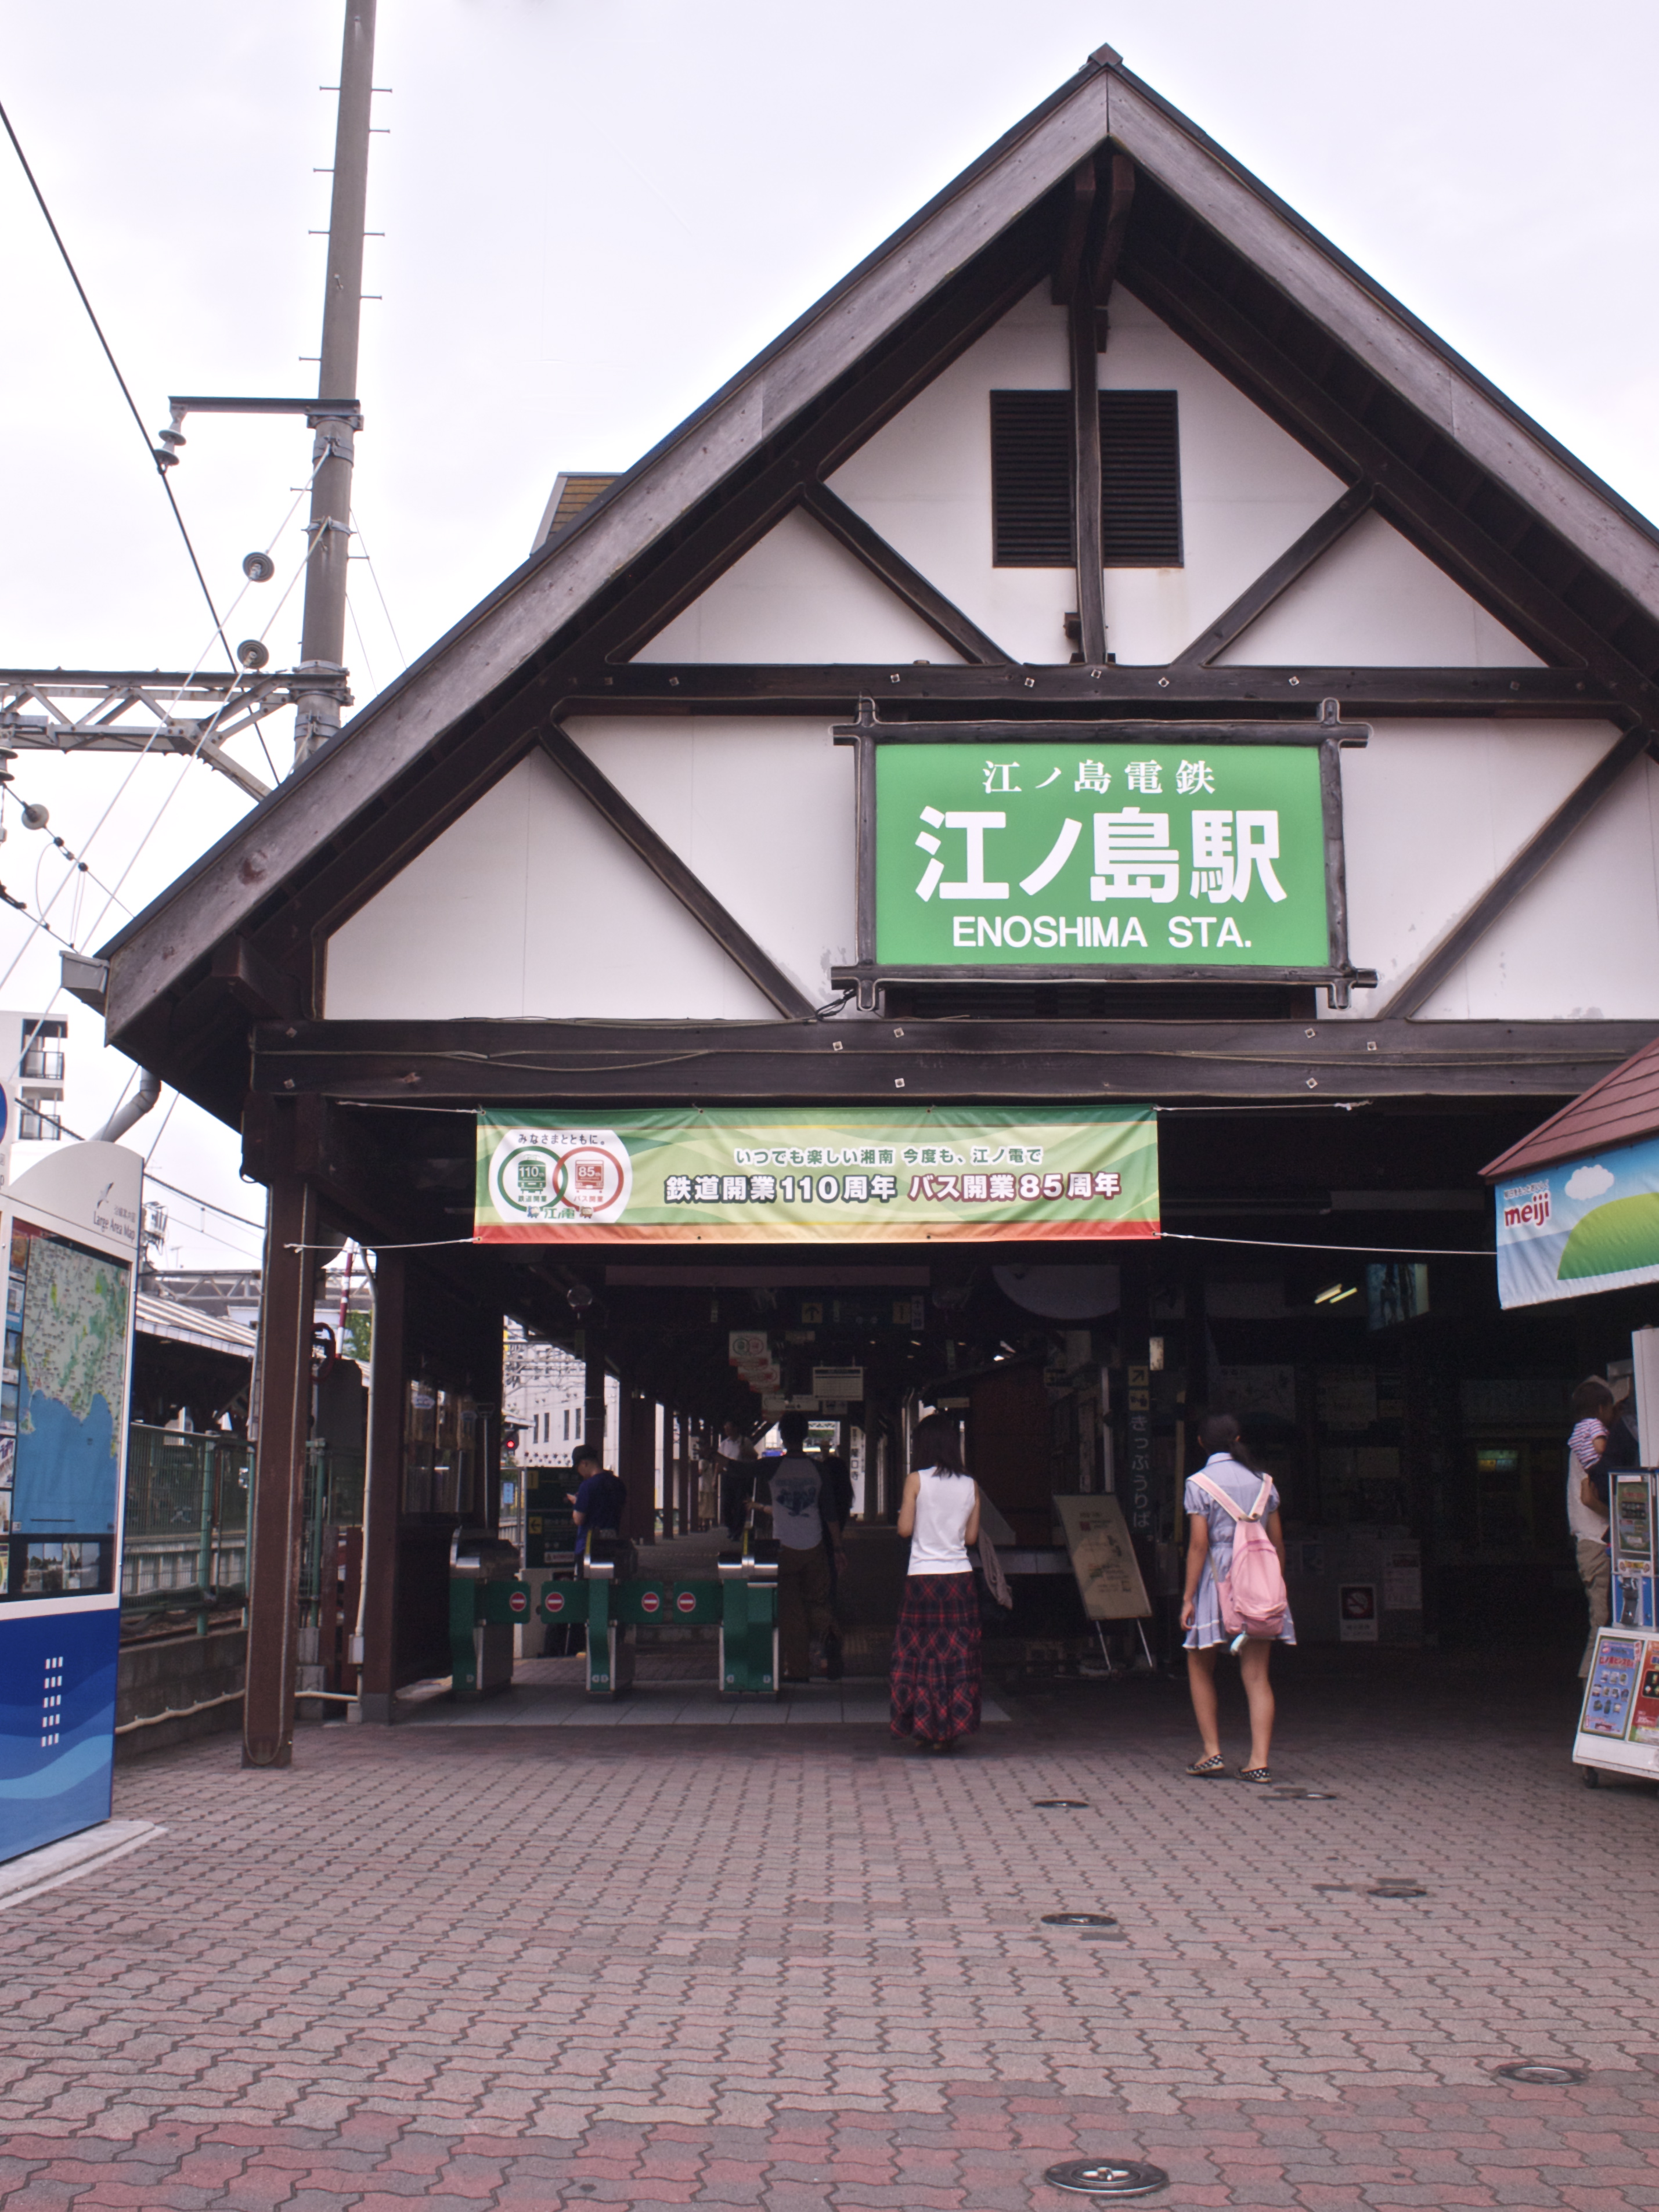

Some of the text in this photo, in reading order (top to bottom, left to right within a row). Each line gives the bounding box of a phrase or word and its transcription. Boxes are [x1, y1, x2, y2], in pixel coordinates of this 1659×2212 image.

[982, 759, 1217, 795] 江ノ島電鉄
[915, 806, 1287, 903] 江ノ島駅
[953, 915, 1252, 948] ENOSHIMA STA.
[518, 1134, 605, 1146] みなさまとともに。
[736, 1148, 1042, 1165] いつでも楽しい湘南 今度も、江ノ電で
[665, 1173, 1121, 1201] 鉄道開業110周年 バス開業85周年
[543, 1207, 576, 1219] 江ノ電
[1505, 1193, 1549, 1226] meiji
[93, 1211, 135, 1243] Large Area Map
